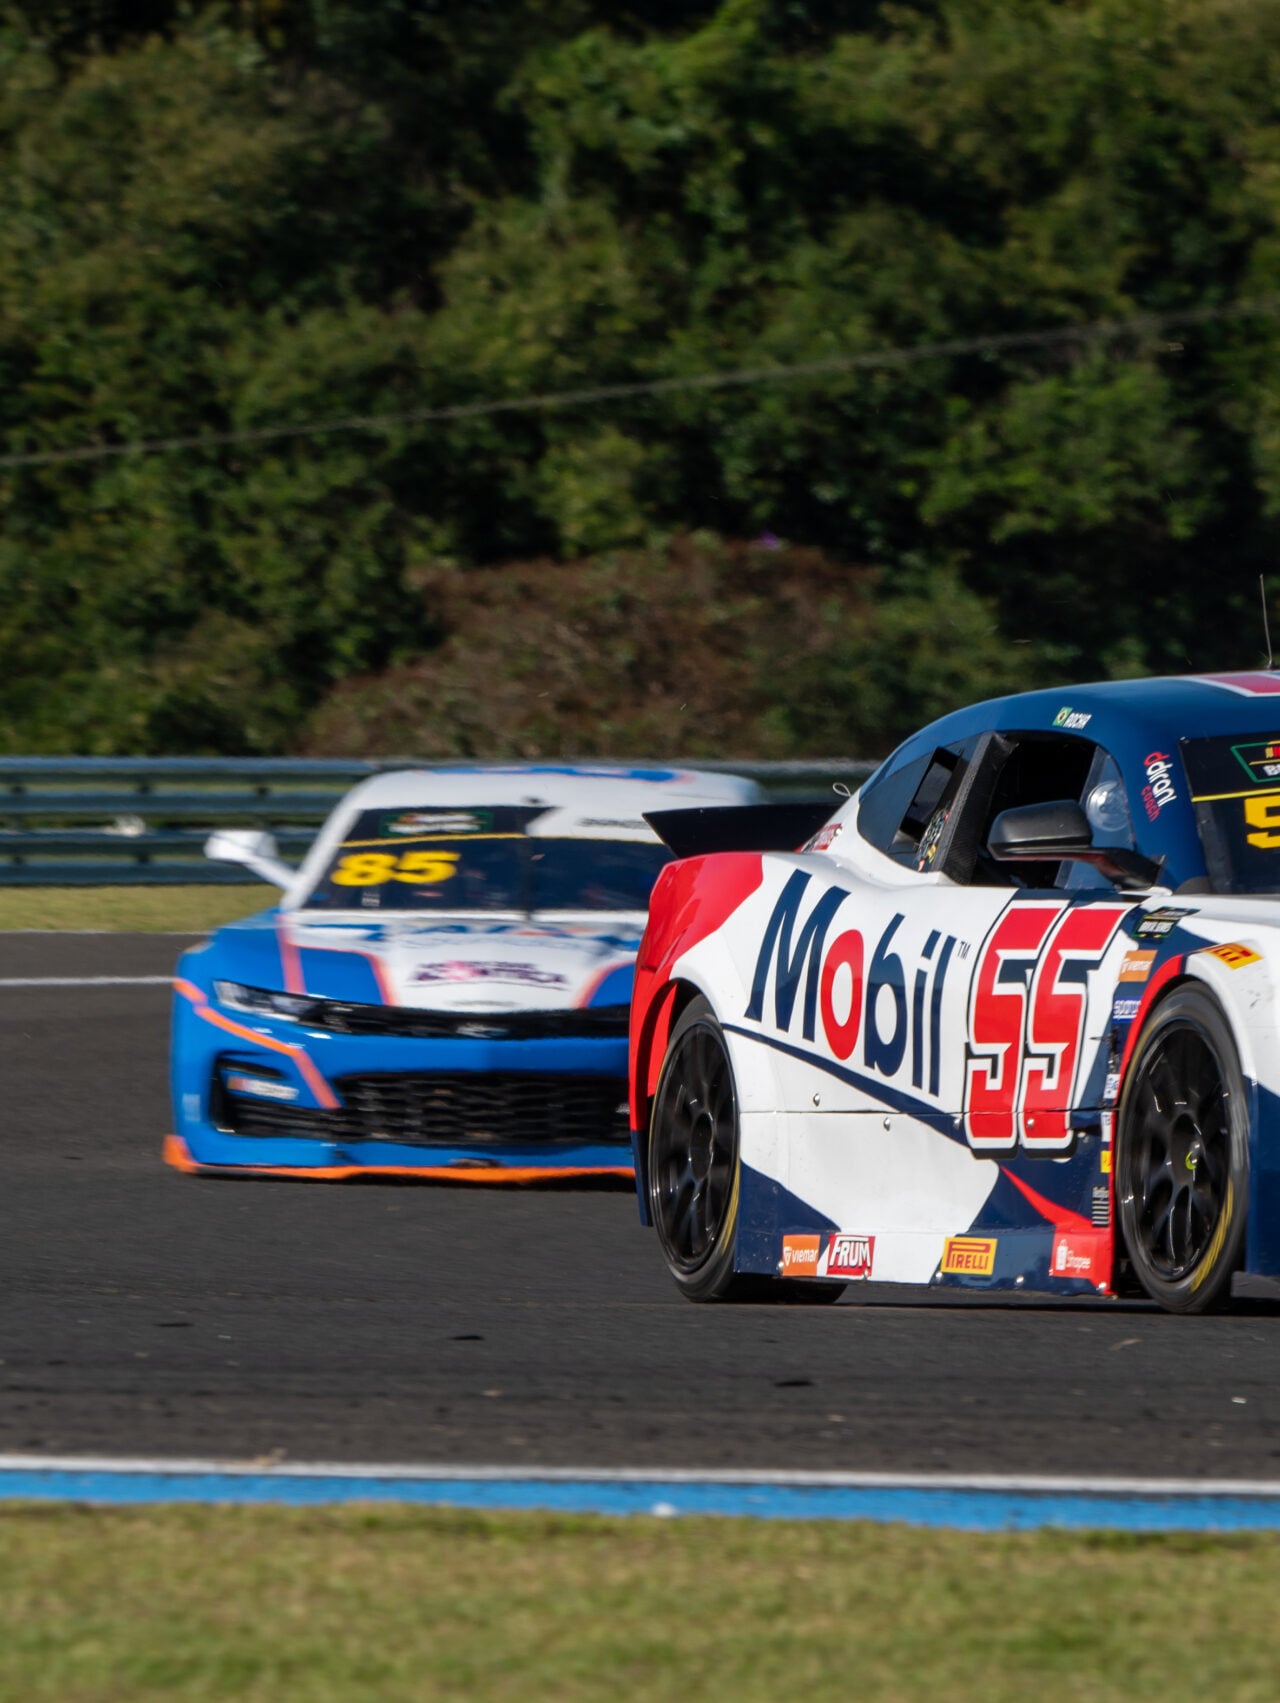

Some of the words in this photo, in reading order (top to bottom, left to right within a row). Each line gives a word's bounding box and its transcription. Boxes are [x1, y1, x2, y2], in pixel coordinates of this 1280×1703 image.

[1141, 785, 1161, 822] coach
[331, 850, 461, 887] 85
[744, 869, 957, 1097] Mobil
[966, 901, 1130, 1158] 55
[791, 1248, 819, 1264] viemar
[829, 1236, 872, 1268] FRUM
[946, 1241, 991, 1270] PIRELLI
